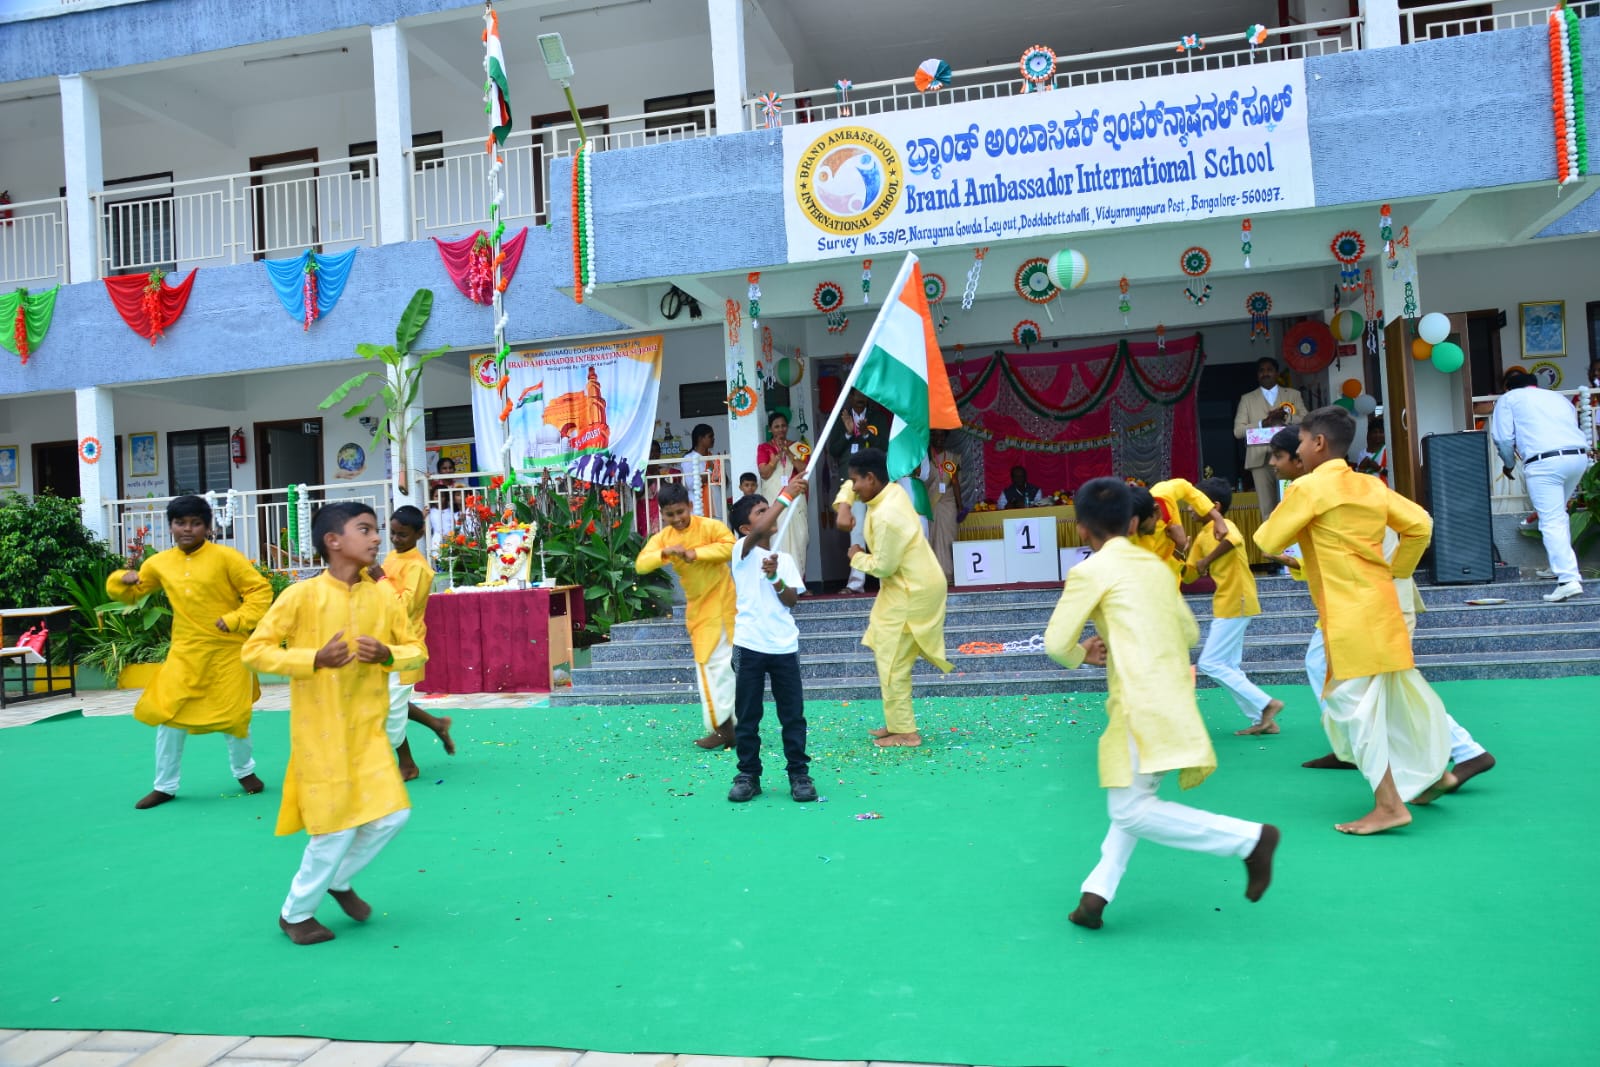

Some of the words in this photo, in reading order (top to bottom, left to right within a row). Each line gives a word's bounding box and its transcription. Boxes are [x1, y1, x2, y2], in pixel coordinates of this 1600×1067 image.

[985, 108, 1099, 158] ಅಂಬಾಸಿಡರ್
[800, 142, 826, 179] BRAND
[828, 130, 895, 166] AMBASSADOR
[905, 178, 961, 214] Brand
[964, 168, 1074, 207] Ambassador
[1076, 150, 1197, 194] International
[1204, 141, 1275, 179] School
[801, 192, 872, 231] INTERNATIONAL
[873, 180, 899, 221] SCHOOL
[818, 236, 859, 254] Survey
[956, 219, 982, 236] Gowda
[530, 356, 574, 367] AMBASSADOR
[576, 350, 628, 363] INTERNATIONAL
[1022, 525, 1035, 549] 1
[971, 552, 984, 573] 2
